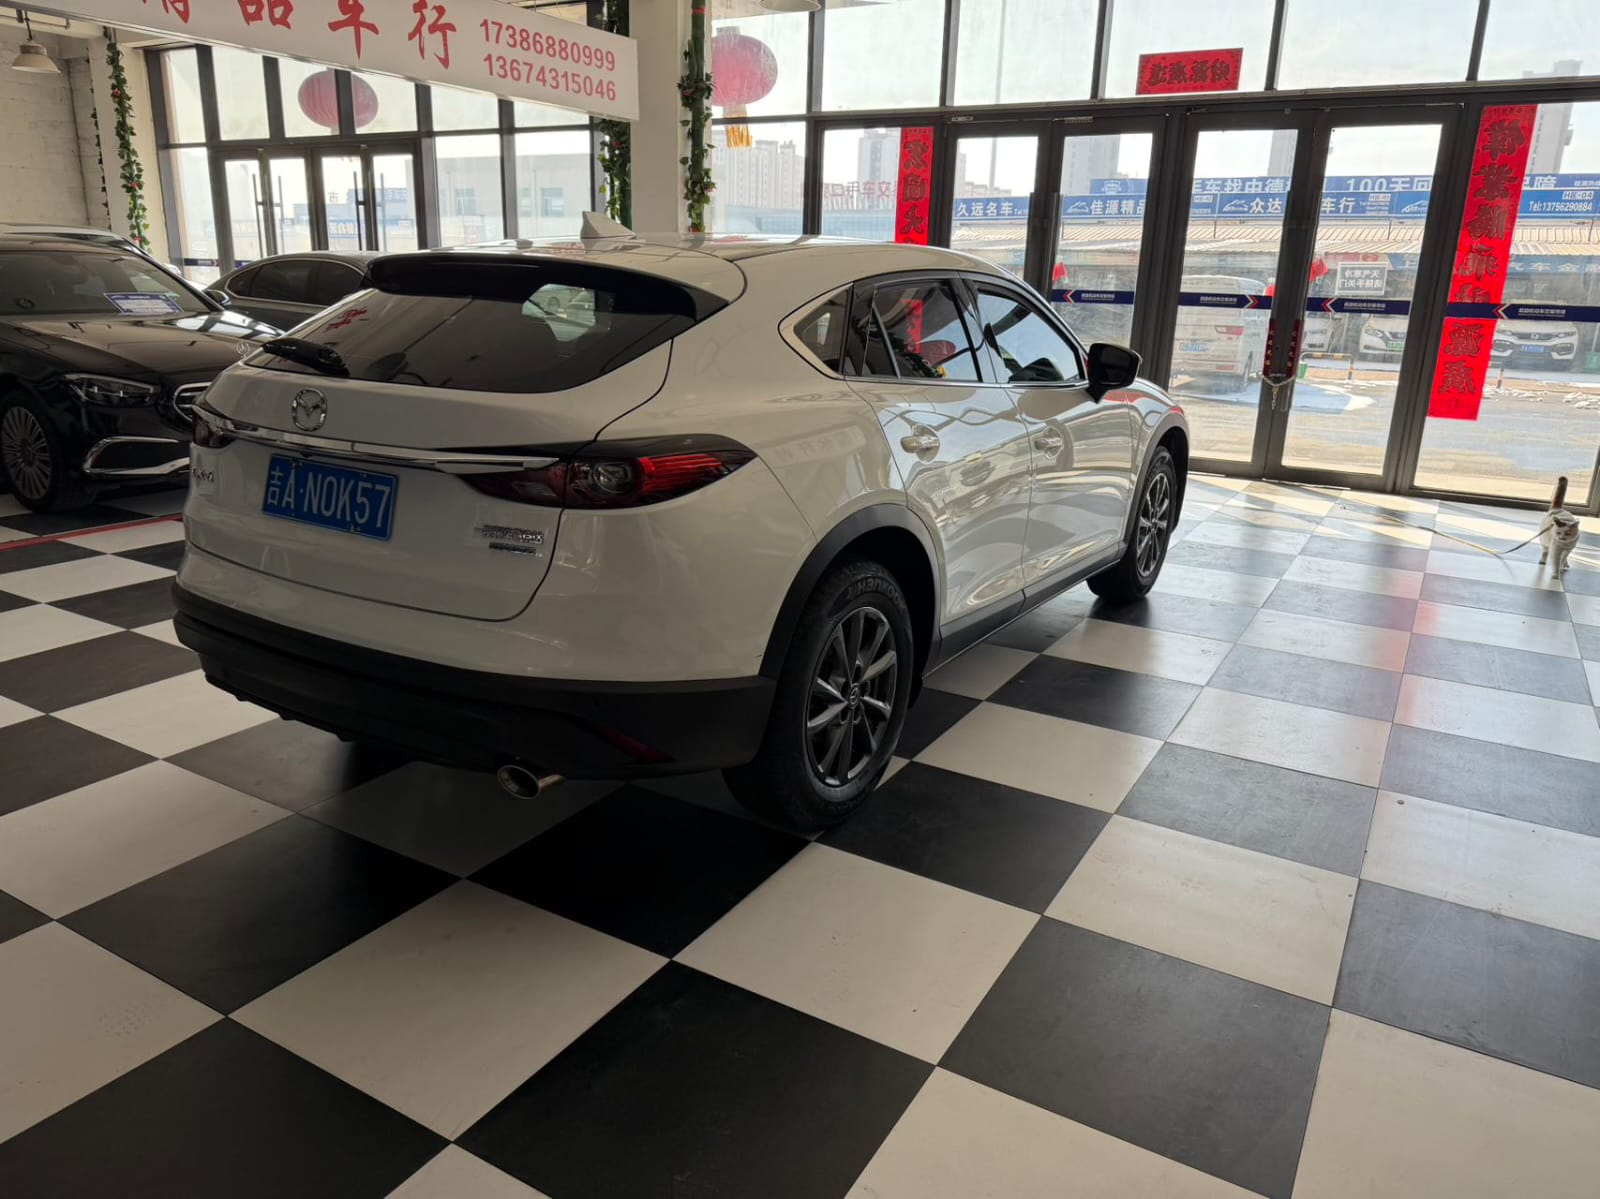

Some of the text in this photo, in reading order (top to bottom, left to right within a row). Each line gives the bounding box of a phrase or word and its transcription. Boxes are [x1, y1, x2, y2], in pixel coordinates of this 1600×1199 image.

[479, 18, 616, 72] 17386880999
[483, 53, 617, 101] 13674315046
[957, 202, 1014, 217] 久远名车
[1248, 197, 1282, 214] 众达
[1320, 197, 1356, 214] 车行
